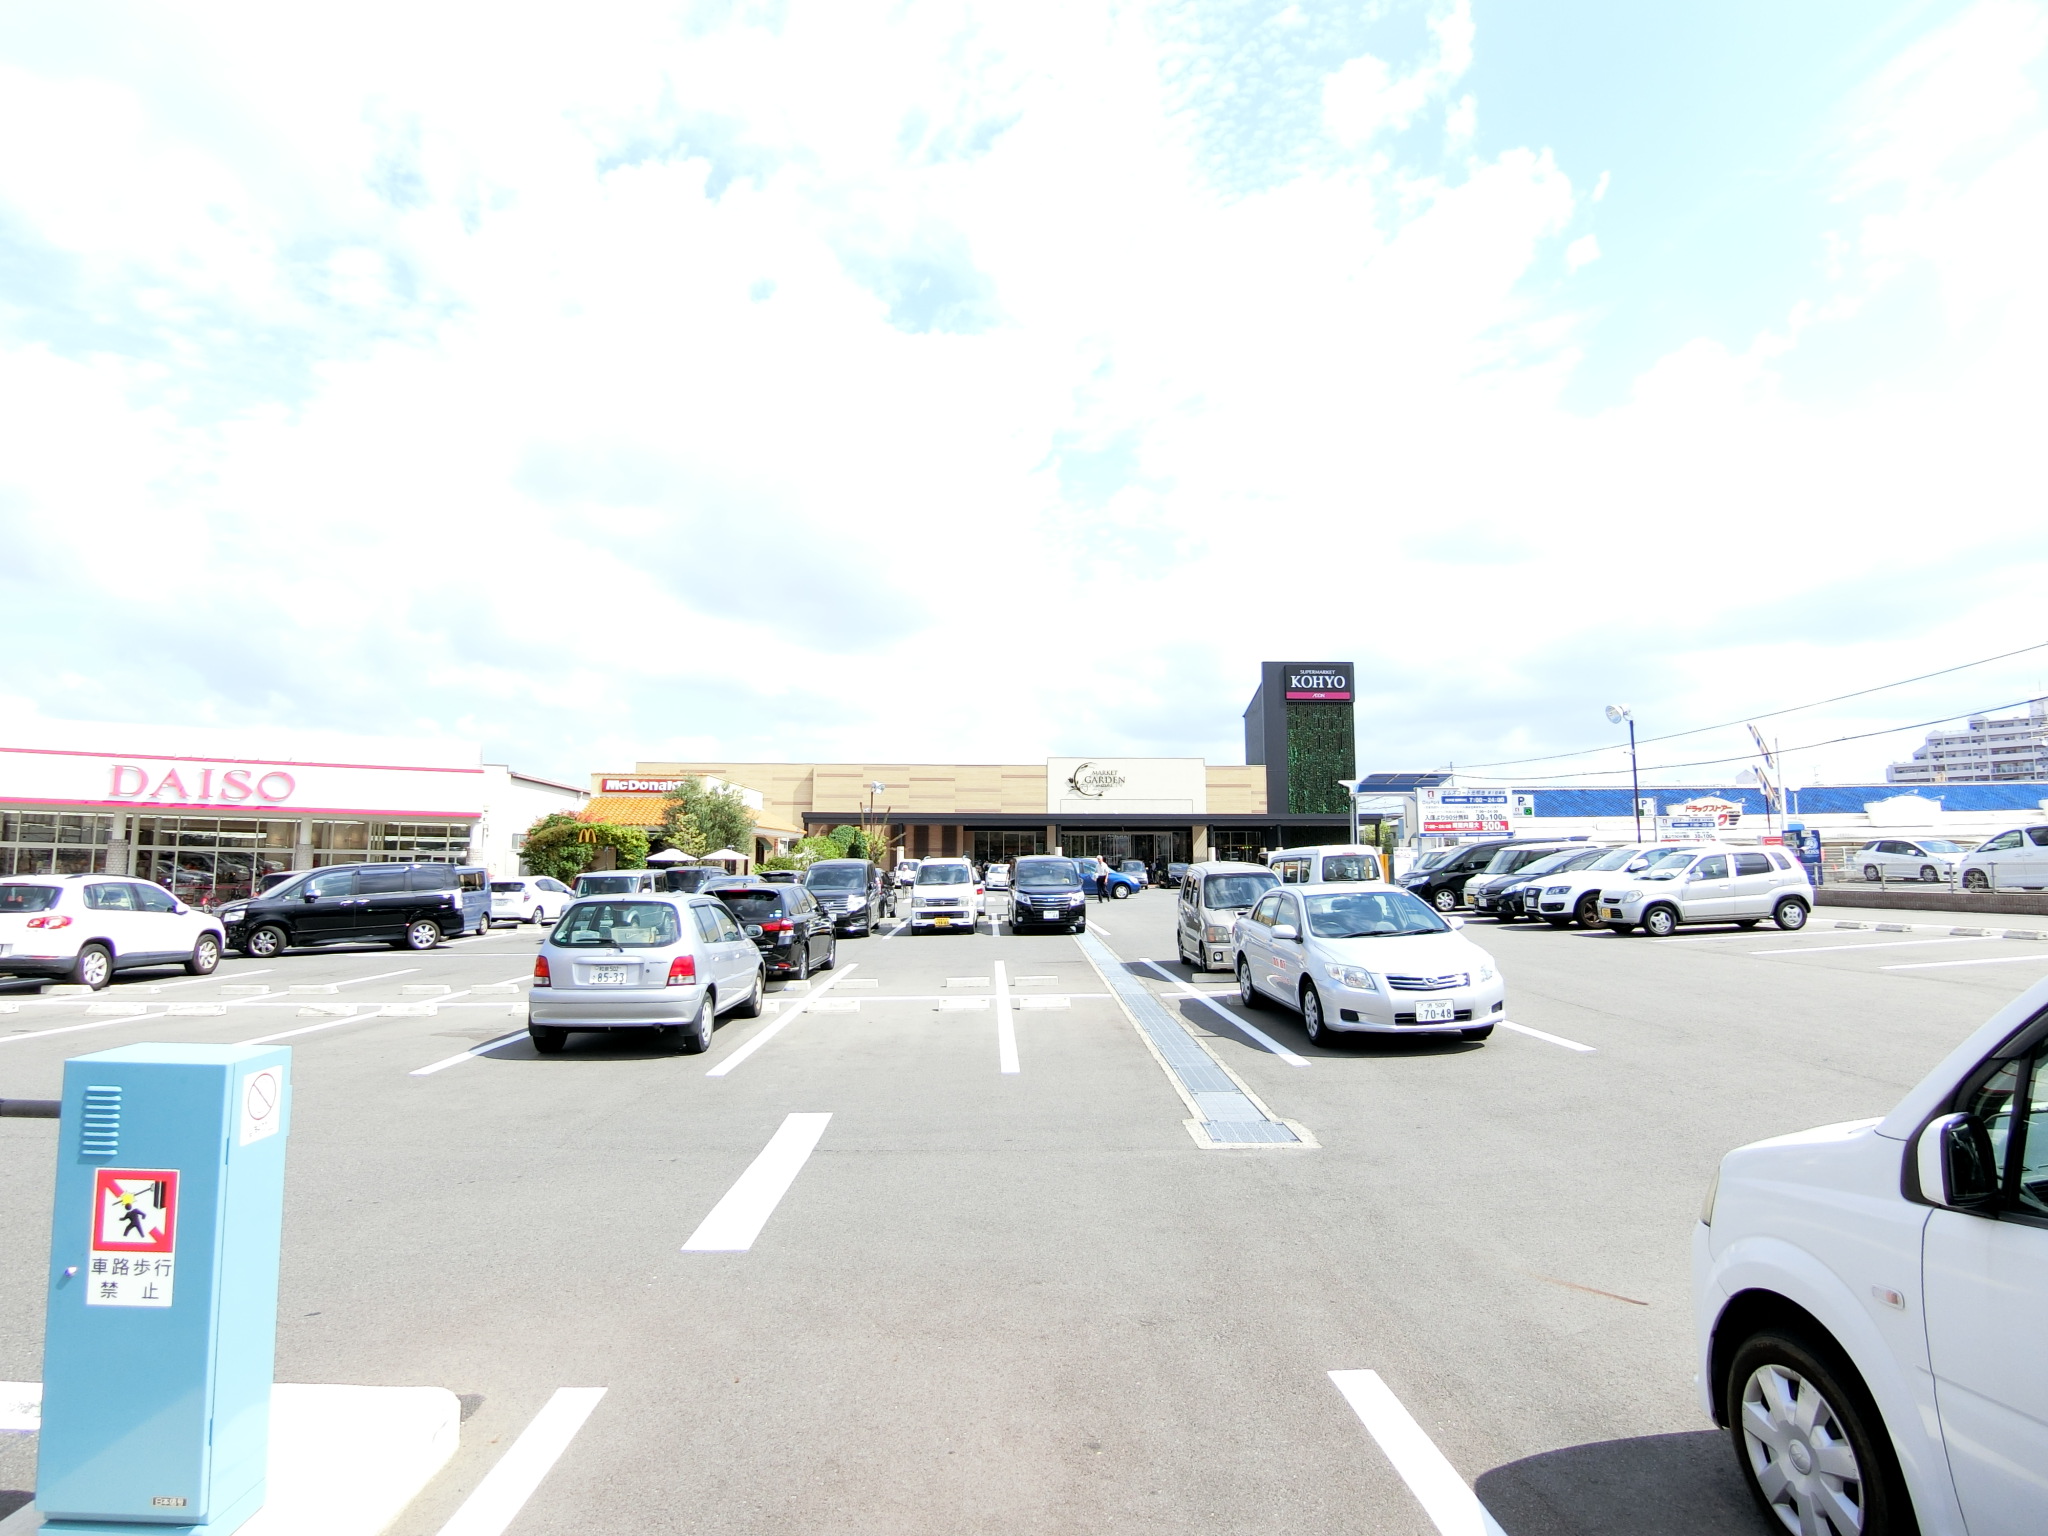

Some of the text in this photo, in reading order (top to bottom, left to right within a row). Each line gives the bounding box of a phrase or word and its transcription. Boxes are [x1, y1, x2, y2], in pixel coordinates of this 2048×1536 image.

[1290, 675, 1346, 688] KOHYO
[108, 764, 296, 803] DAISO
[1084, 776, 1126, 784] GARDEN
[1518, 796, 1525, 806] P
[597, 972, 625, 983] 85-33
[1424, 1008, 1452, 1019] 70-48
[91, 1257, 172, 1277] 車路歩行
